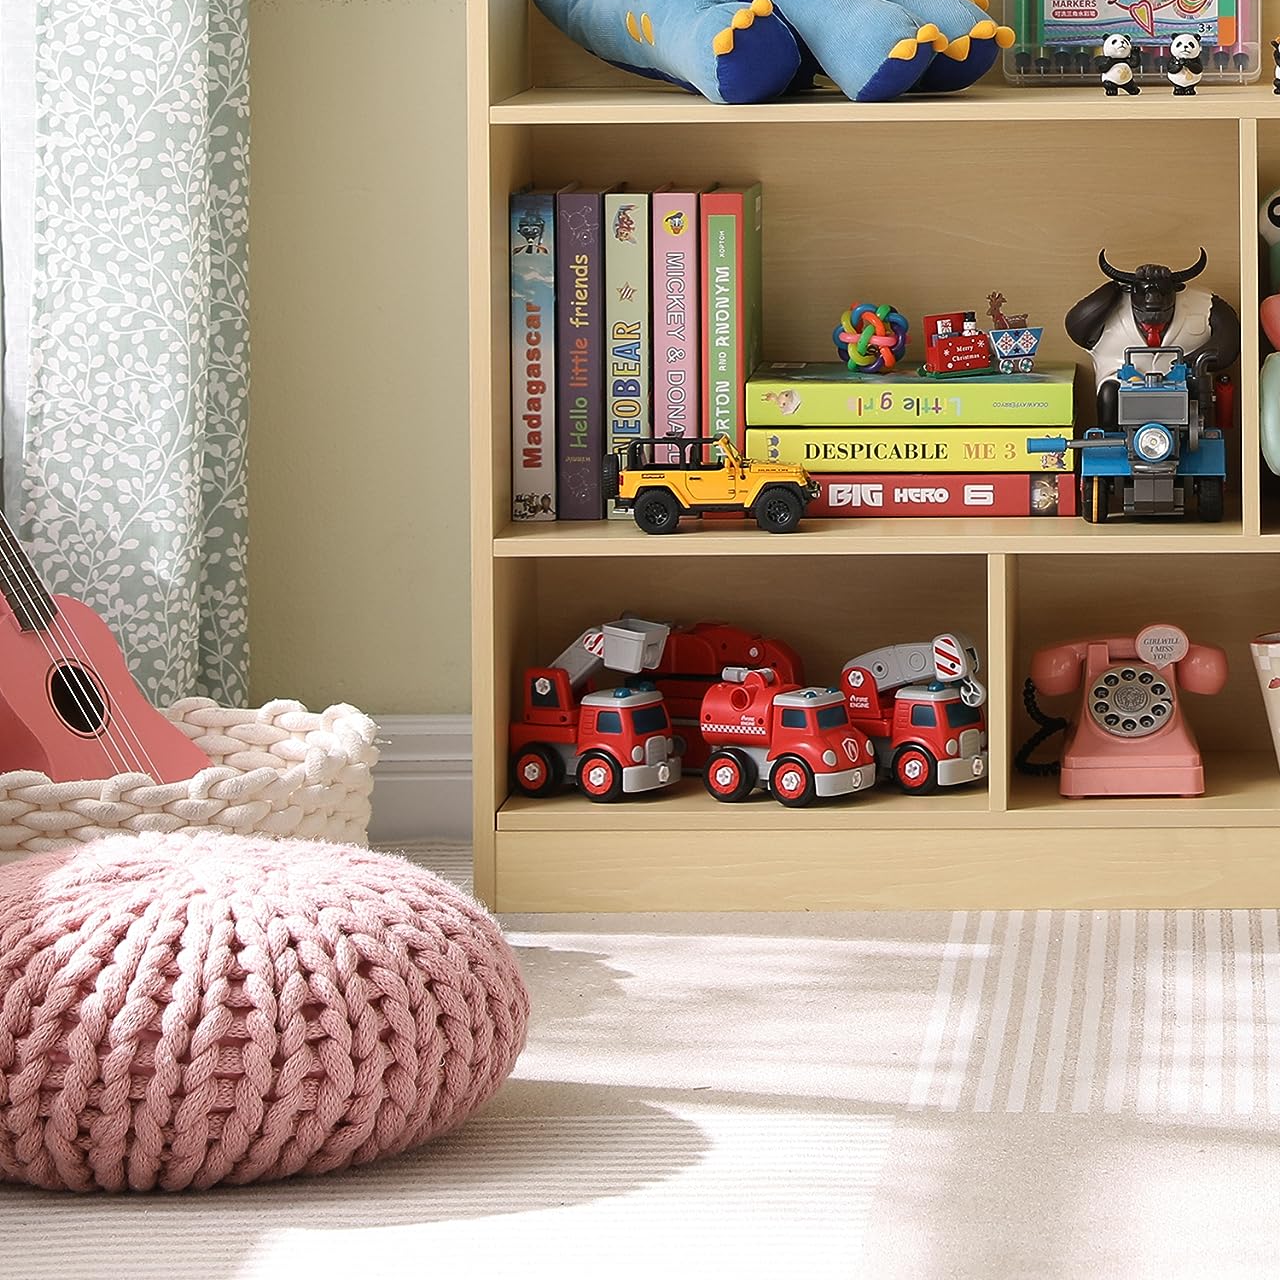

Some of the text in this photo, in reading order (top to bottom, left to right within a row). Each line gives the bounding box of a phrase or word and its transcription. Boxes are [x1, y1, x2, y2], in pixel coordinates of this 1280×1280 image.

[1052, 0, 1097, 8] MARKERS
[1199, 23, 1213, 33] 3+
[666, 252, 686, 342] MICKEY
[568, 253, 589, 449] Hello little friends
[666, 346, 686, 364] &
[951, 353, 980, 362] Christmas
[956, 345, 974, 353] Merry
[522, 302, 547, 469] Madagascar
[903, 397, 962, 417] Little
[804, 442, 1017, 461] DESPICABLE ME 3
[828, 483, 994, 508] BIG HERO 6
